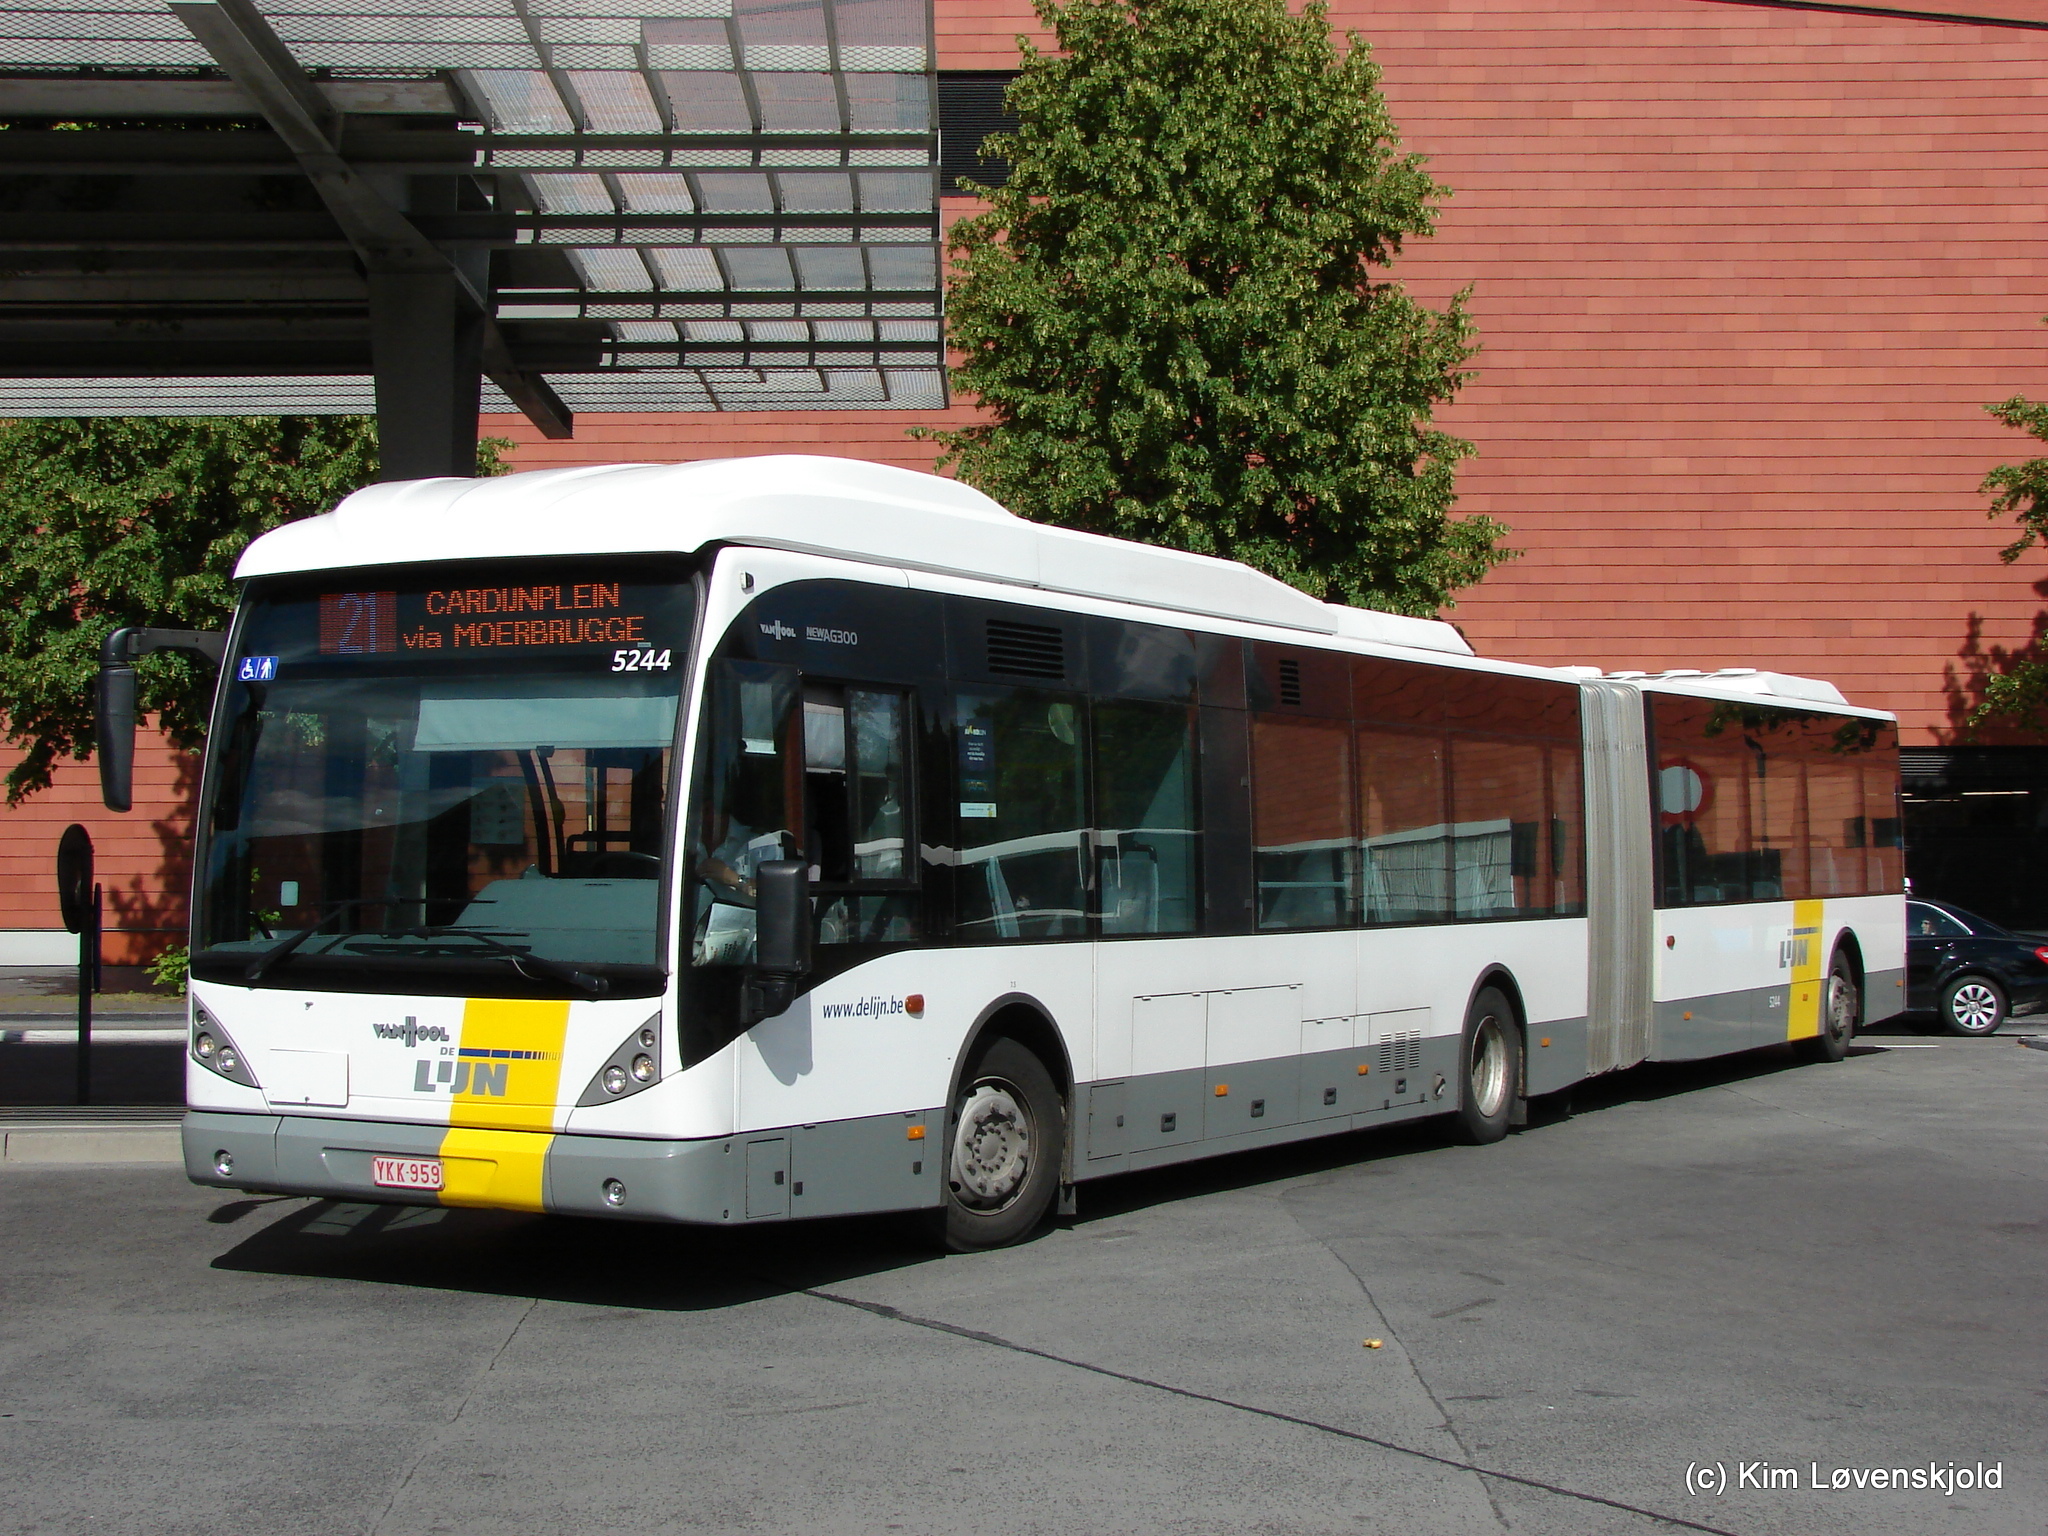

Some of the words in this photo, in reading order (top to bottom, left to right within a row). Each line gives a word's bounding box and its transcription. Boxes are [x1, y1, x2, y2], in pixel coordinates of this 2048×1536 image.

[338, 592, 377, 653] 21
[402, 626, 442, 649] via
[454, 617, 645, 648] MOERBRUGGE
[611, 648, 672, 673] 5244
[822, 996, 904, 1020] www.delijn.be
[440, 1047, 455, 1056] DE
[413, 1059, 509, 1096] LIJN
